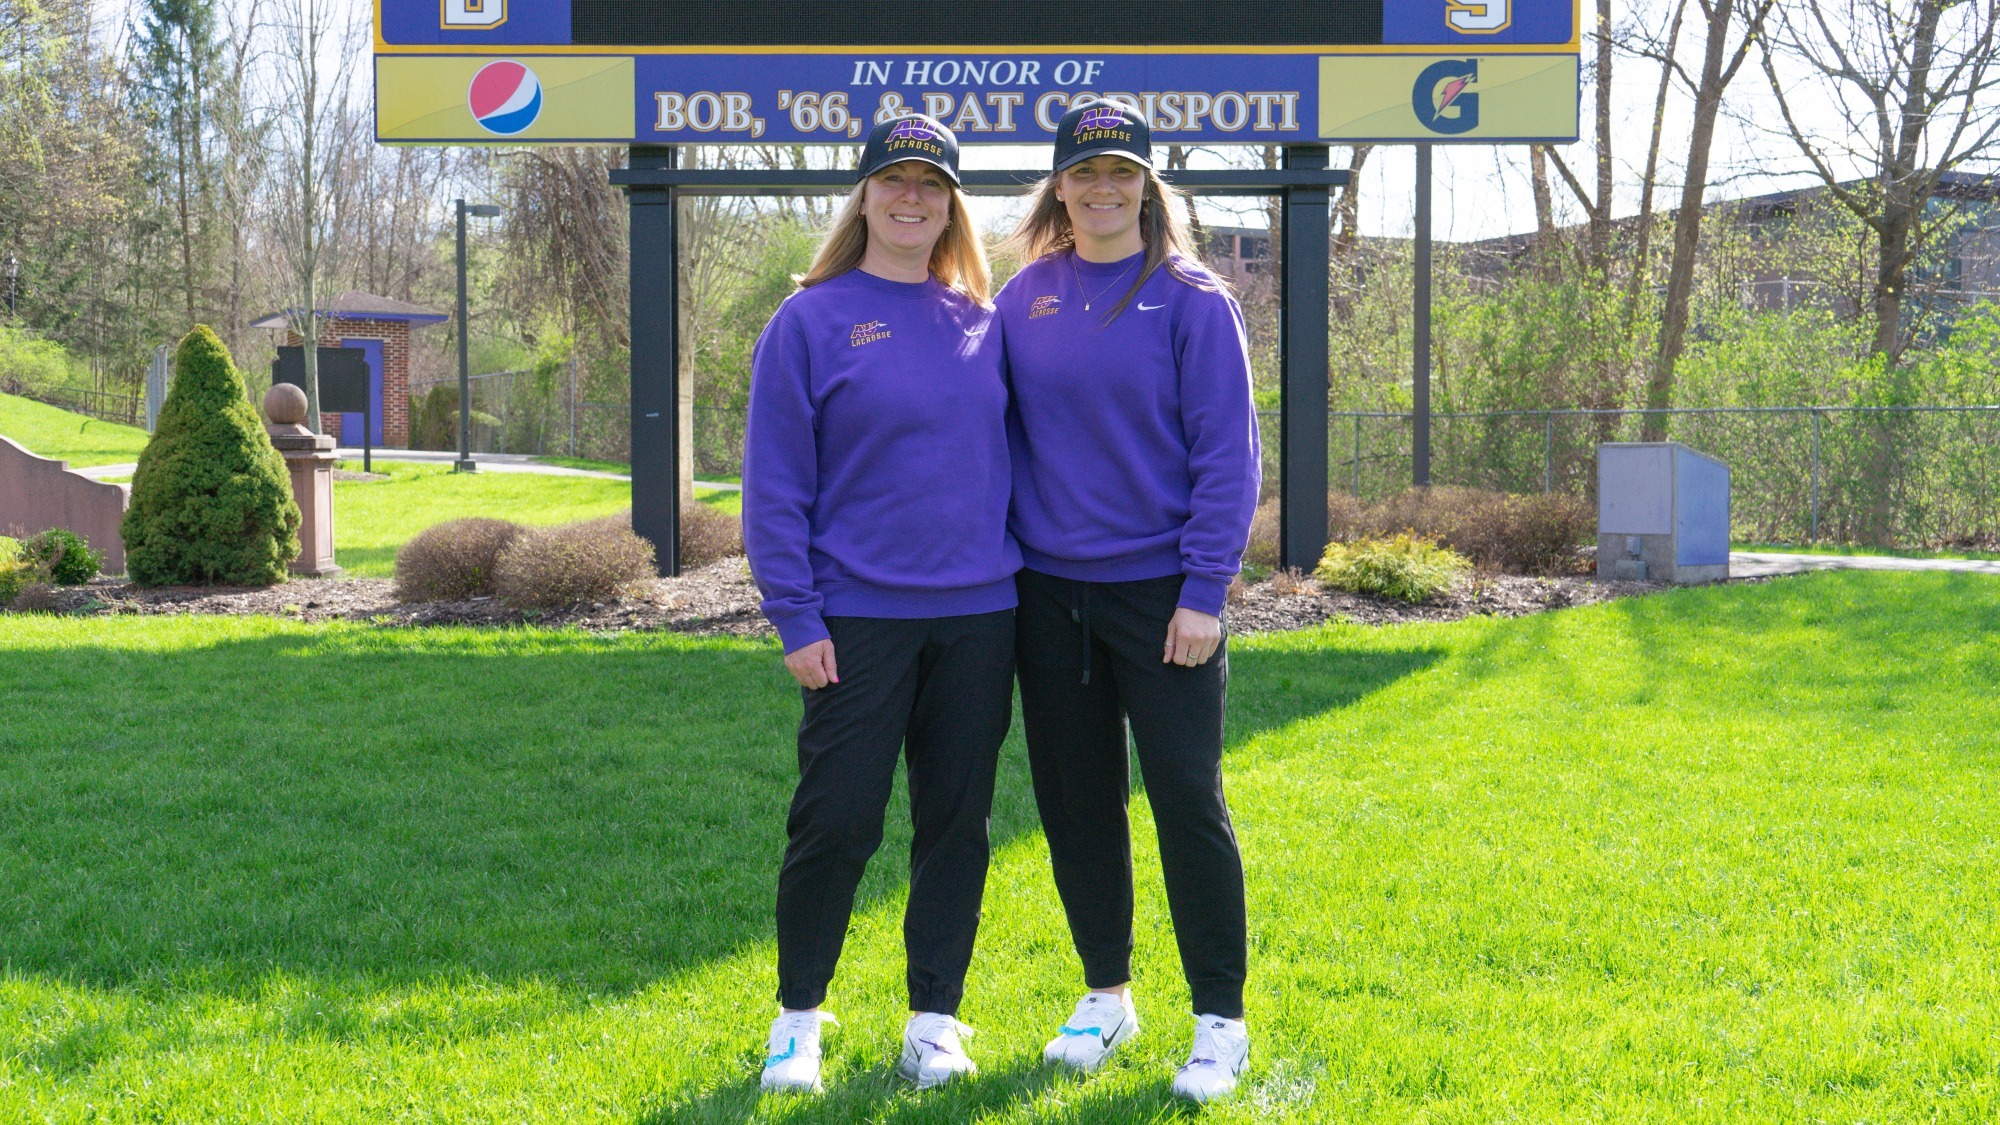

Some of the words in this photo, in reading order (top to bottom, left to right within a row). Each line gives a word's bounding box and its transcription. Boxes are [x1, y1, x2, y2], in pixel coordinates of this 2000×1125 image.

[850, 60, 894, 86] IN
[902, 60, 1041, 86] HONOR
[1054, 60, 1104, 86] OF
[654, 91, 765, 138] BOB,
[778, 90, 862, 138] '66,
[874, 91, 913, 126] &
[922, 92, 1024, 132] PAT
[1076, 130, 1131, 145] LACROSSE
[888, 140, 943, 157] LACROSSE
[851, 330, 892, 347] LACROSSE
